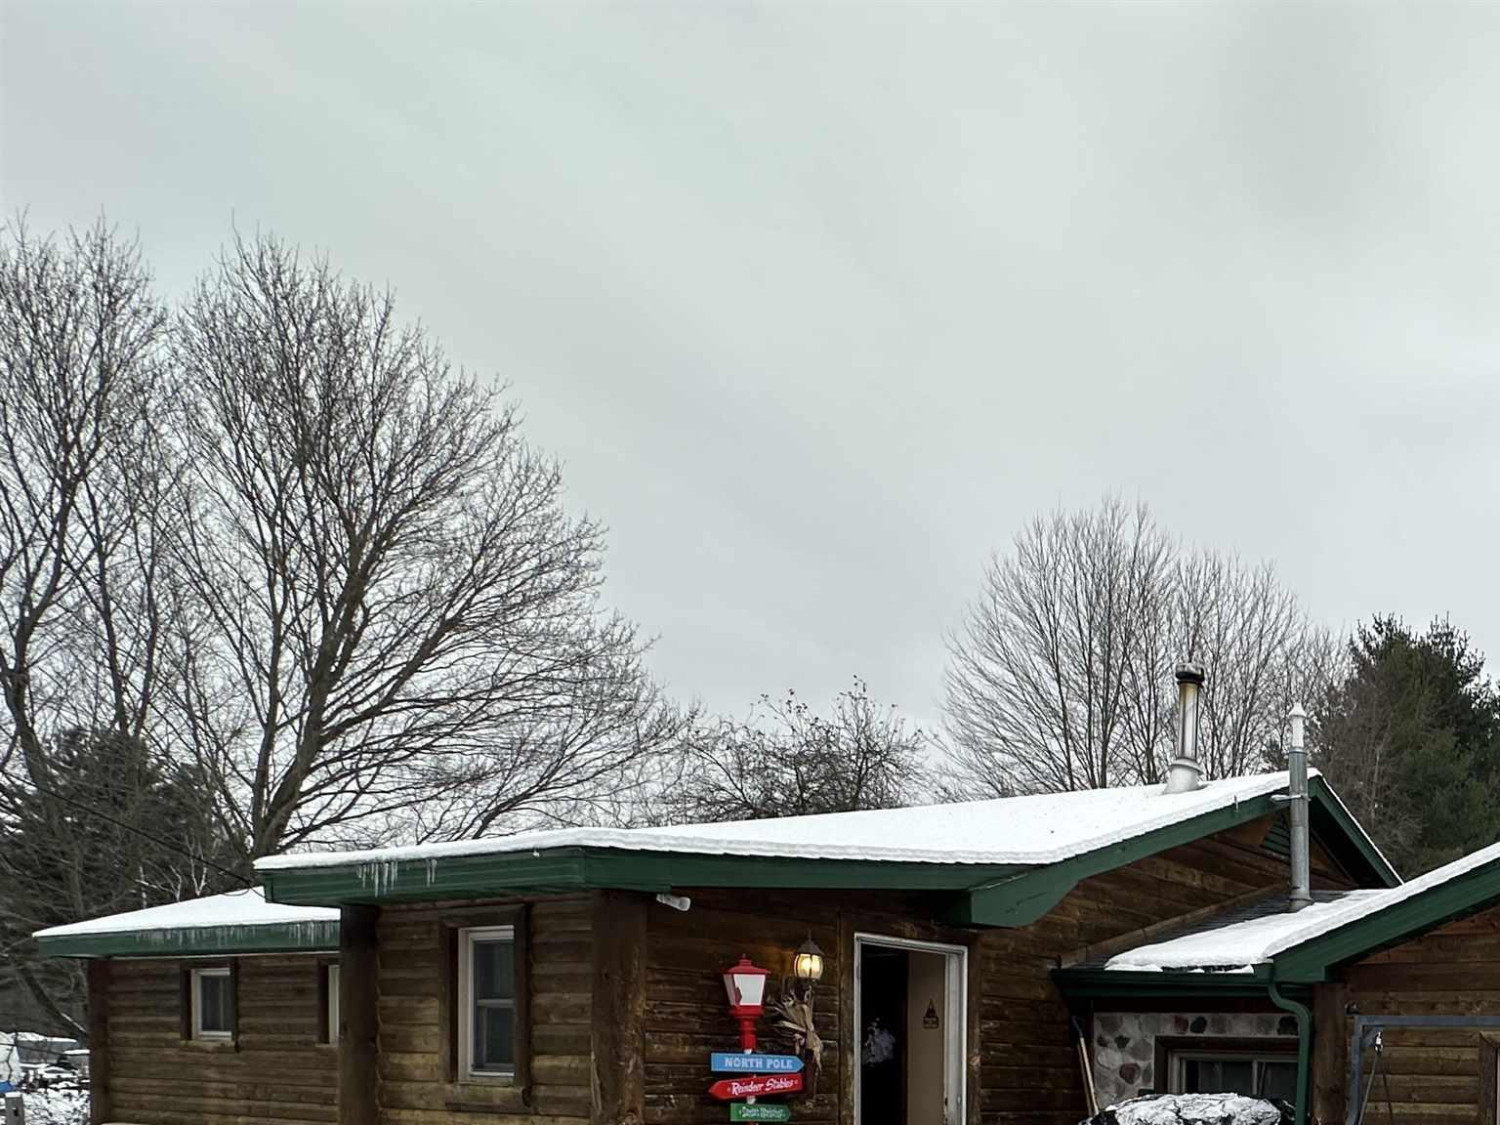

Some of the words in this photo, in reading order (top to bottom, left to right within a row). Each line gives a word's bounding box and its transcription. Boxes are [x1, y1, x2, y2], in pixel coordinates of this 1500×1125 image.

[724, 1057, 762, 1069] NORTH
[766, 1058, 793, 1070] POLE
[731, 1082, 764, 1096] Reindeer
[764, 1078, 794, 1091] Stables
